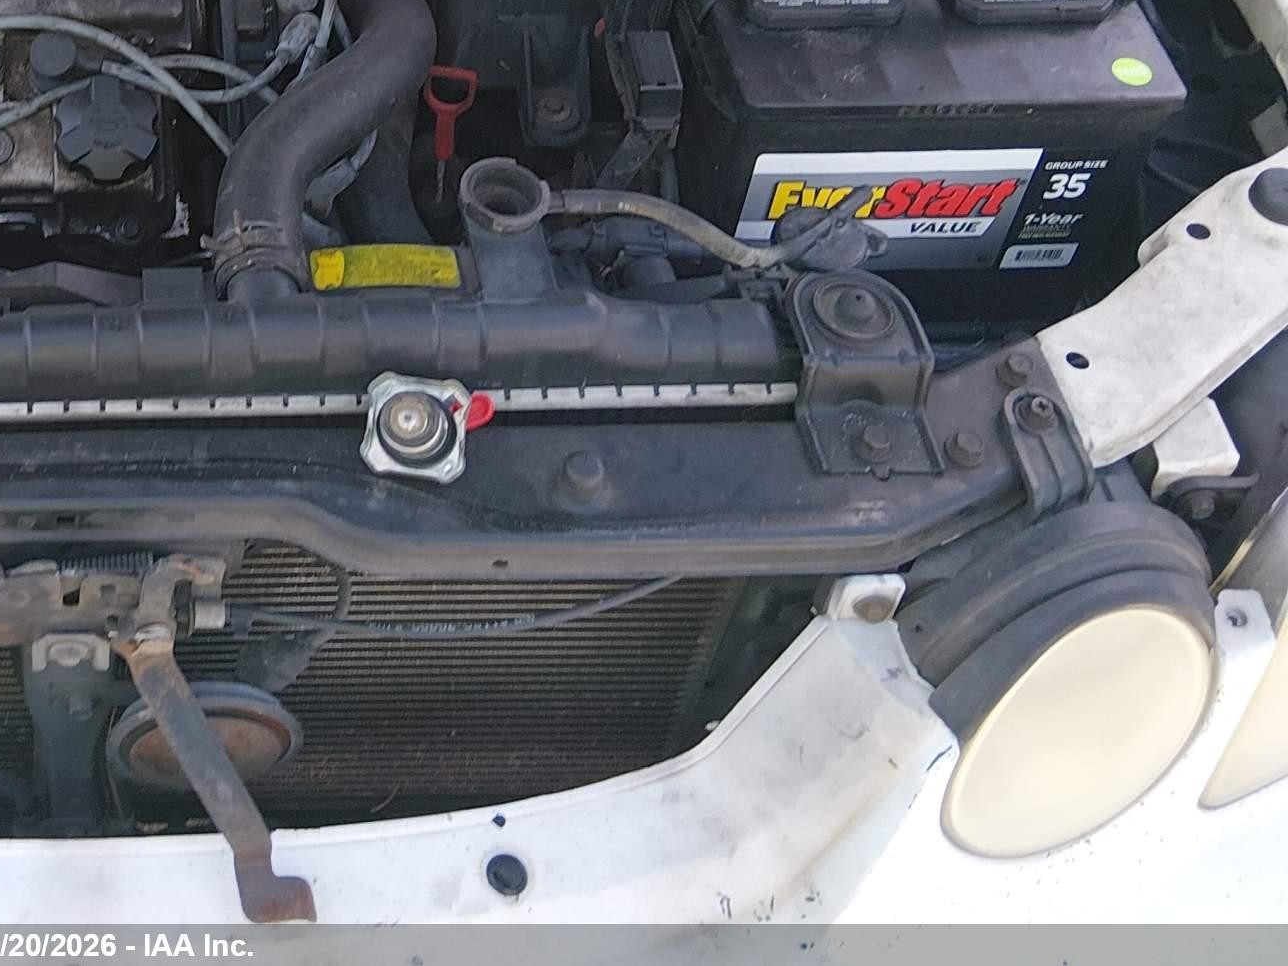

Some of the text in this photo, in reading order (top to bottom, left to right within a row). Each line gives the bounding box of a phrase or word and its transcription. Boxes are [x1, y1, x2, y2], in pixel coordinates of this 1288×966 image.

[1044, 159, 1109, 170] GROUP SIZE
[1043, 173, 1091, 199] 35
[910, 221, 978, 234] VALUE
